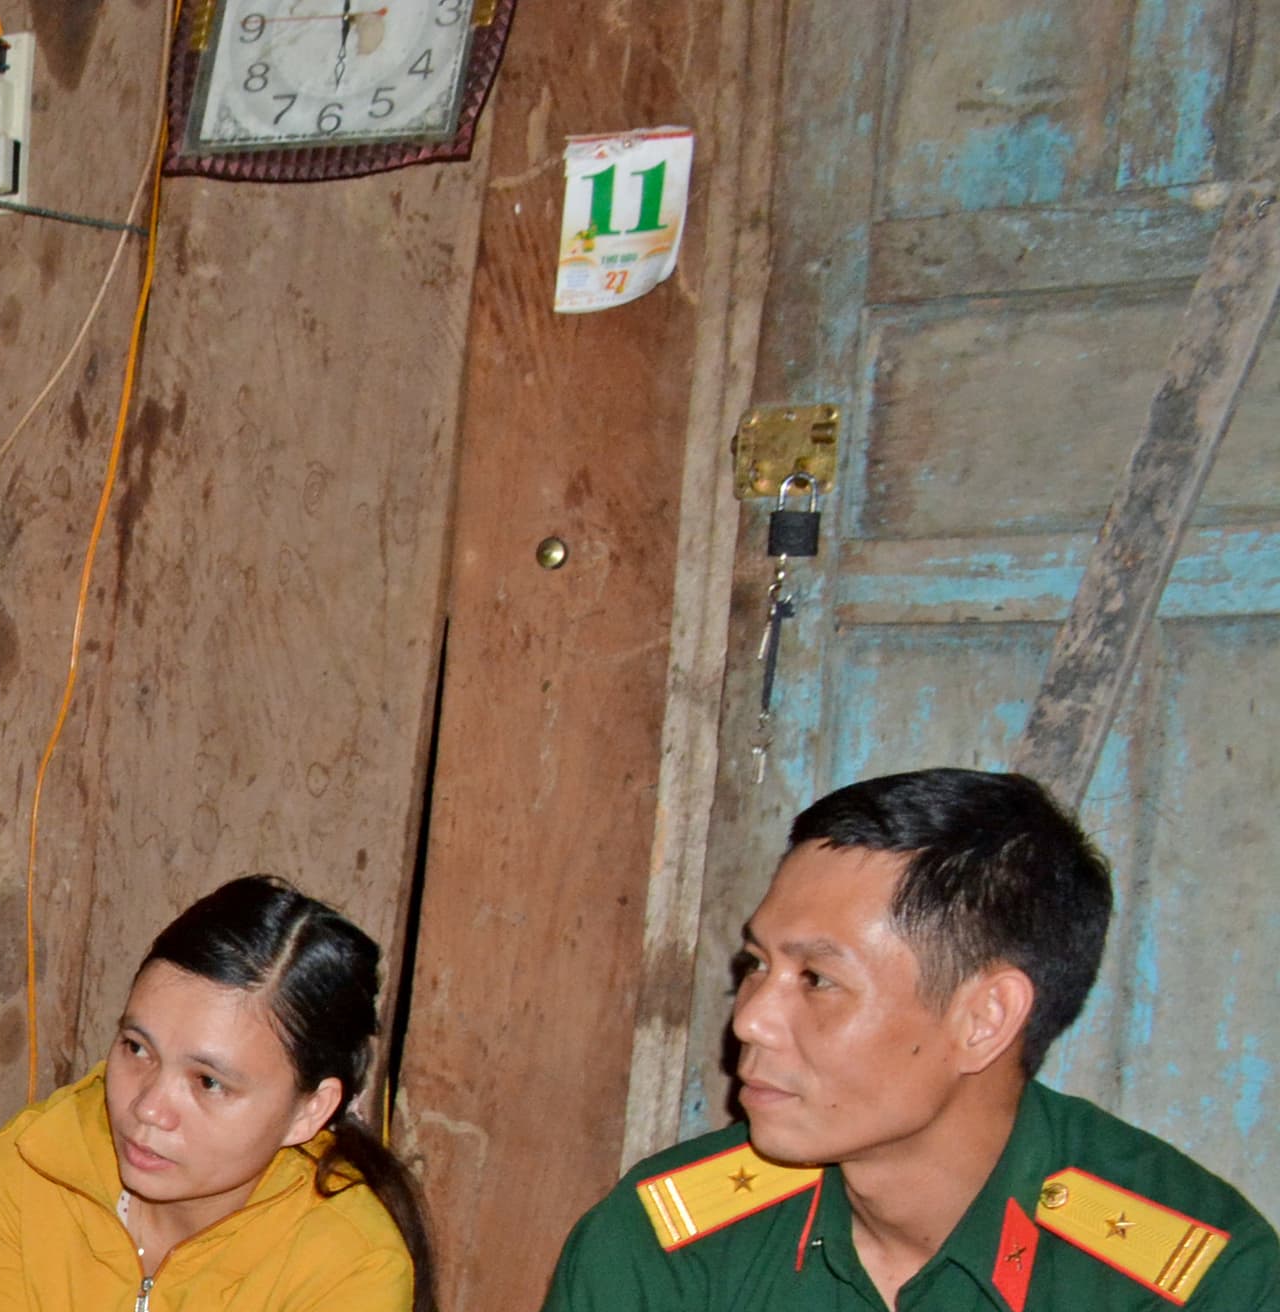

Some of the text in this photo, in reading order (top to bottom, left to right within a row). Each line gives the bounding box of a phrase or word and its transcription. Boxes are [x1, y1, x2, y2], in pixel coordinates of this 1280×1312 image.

[240, 13, 266, 43] 9
[435, 0, 461, 27] 3
[244, 62, 270, 92] 8
[408, 49, 434, 80] 4
[273, 94, 298, 125] 7
[368, 87, 395, 118] 5
[317, 103, 344, 134] 6
[581, 160, 668, 236] 11
[605, 269, 630, 291] 27
